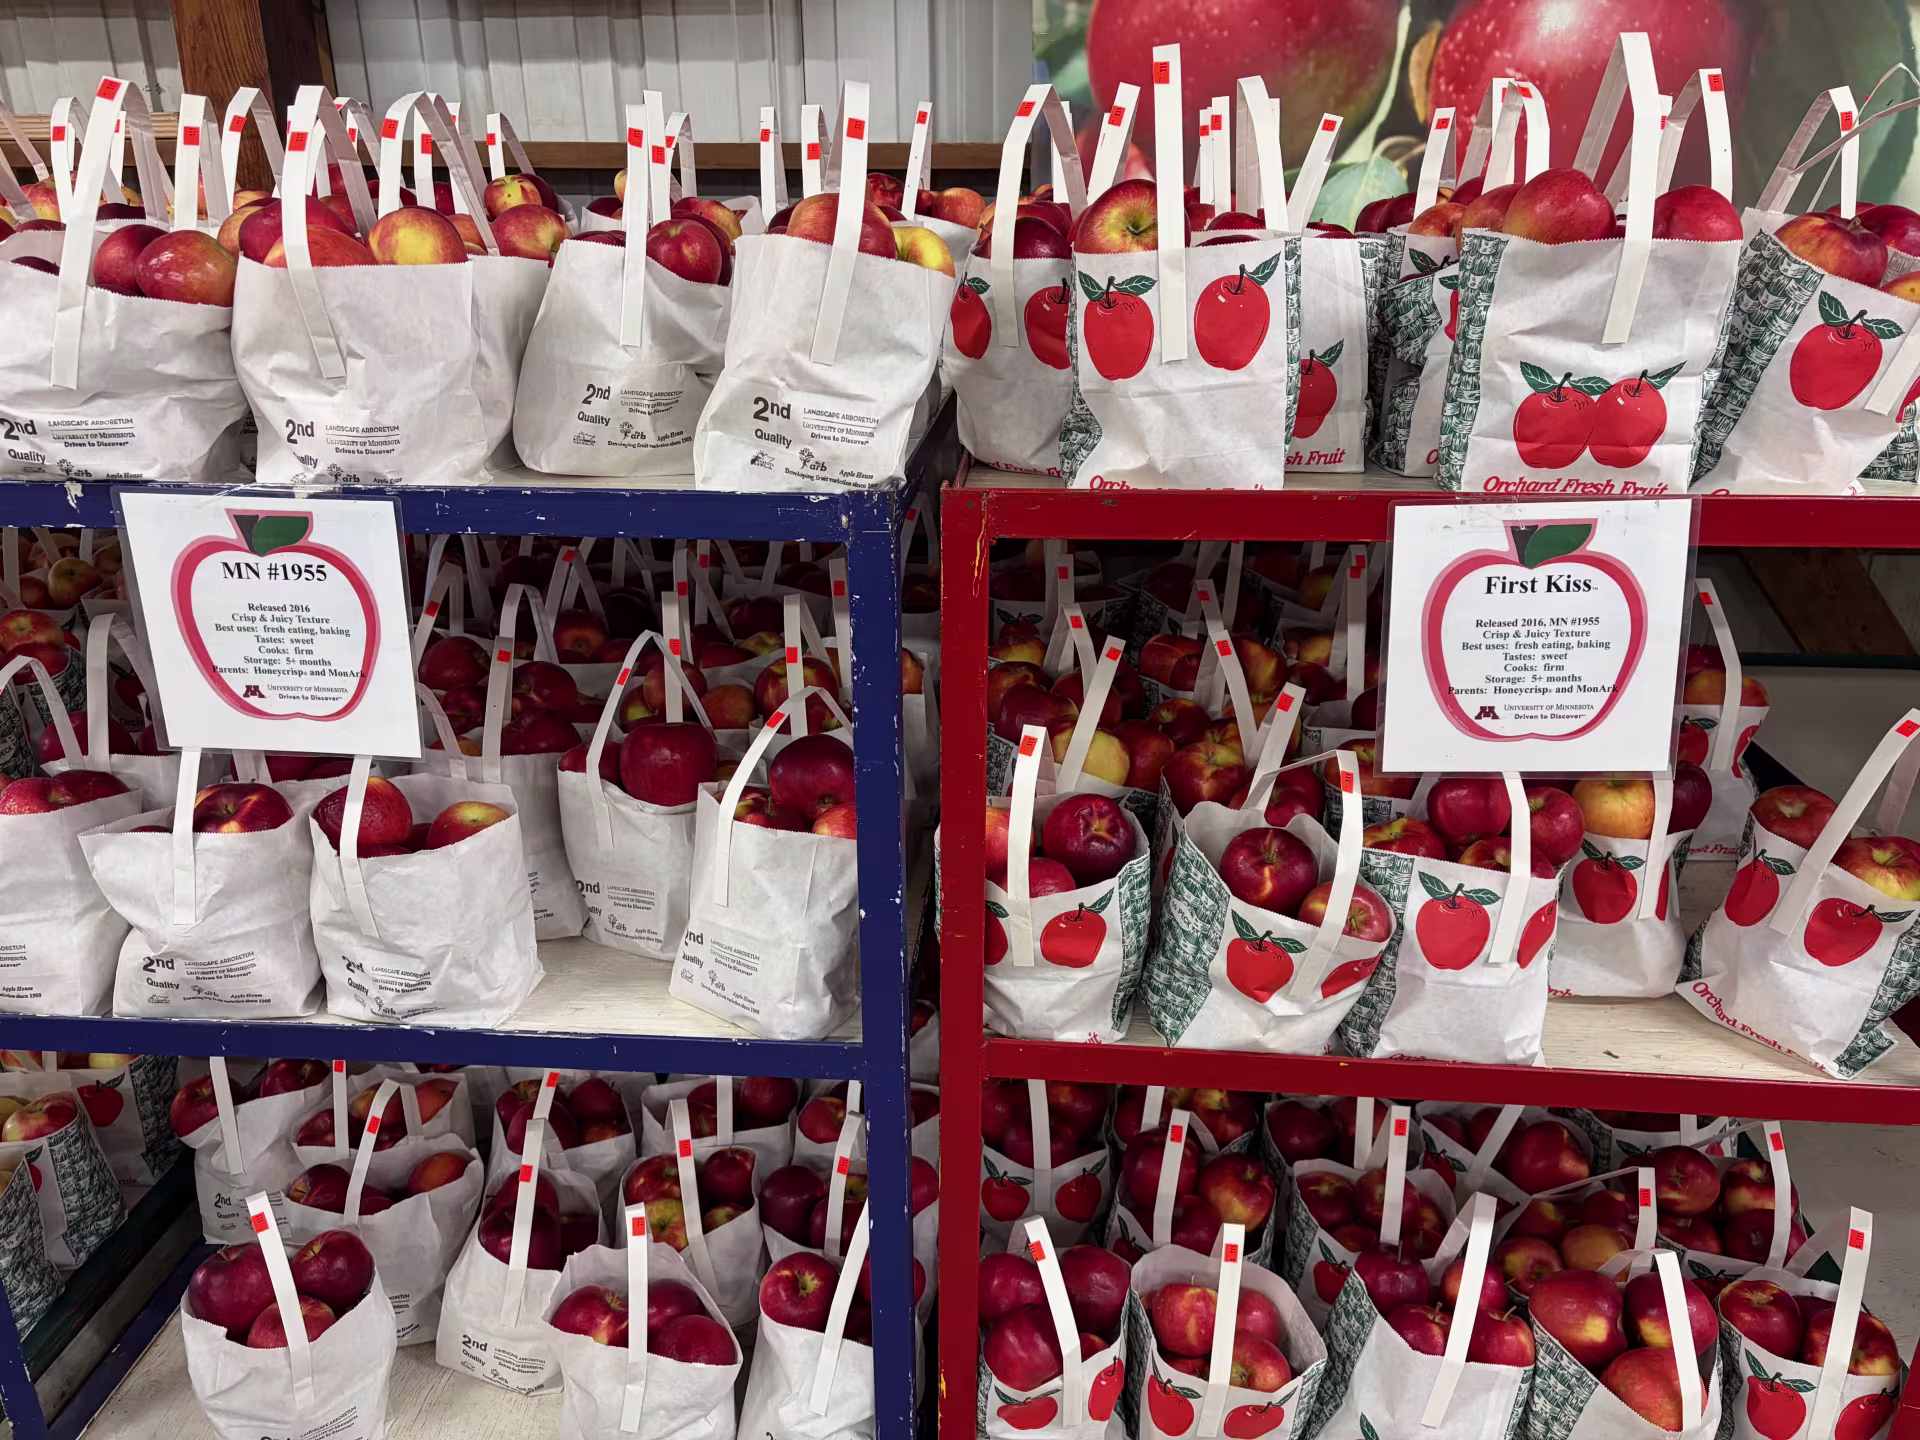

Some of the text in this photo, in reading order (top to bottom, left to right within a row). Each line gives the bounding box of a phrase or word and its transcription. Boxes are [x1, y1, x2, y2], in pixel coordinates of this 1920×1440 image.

[582, 384, 611, 405] 2nd
[620, 390, 653, 398] LANDSCAPE
[629, 407, 647, 416] Driven
[753, 396, 791, 423] 2nd
[578, 411, 611, 426] Quality
[803, 408, 880, 425] LANDSCAPE ARBORETUM
[0, 417, 38, 441] 2nd
[48, 418, 134, 428] LANDSCAPE ARBORETUM
[326, 424, 400, 434] LANDSCAPE ARBORETUM
[802, 422, 837, 433] UNIVERSITY
[98, 432, 136, 440] MINNESOTA
[286, 419, 315, 445] 2nd
[810, 432, 832, 441] Driven
[326, 438, 359, 447] UNIVERSITY
[754, 428, 793, 449] Quality
[64, 441, 87, 449] Driven
[335, 447, 356, 455] Driven
[8, 448, 46, 465] Quality
[1305, 447, 1346, 466] Fruit
[106, 472, 123, 480] Apple
[784, 467, 815, 481] Developing
[839, 469, 874, 480] Apple House
[1483, 476, 1669, 496] Orchard Fresh Fruit
[220, 561, 328, 582] MN #1955
[1484, 576, 1539, 595] First
[248, 602, 311, 613] Released 2016
[232, 613, 331, 625] Crisp & Juicy Texture
[1475, 616, 1600, 628] Released 2016, MN #1955
[214, 623, 351, 637] Best uses: fresh eating, baking
[1482, 628, 1591, 641] Crisp & Juicy Texture
[254, 634, 315, 645] Tastes: sweet
[1462, 640, 1611, 651] Best uses: fresh eating, baking
[258, 646, 314, 656] Cooks: firm
[1502, 652, 1569, 661] Tastes: sweet
[243, 656, 332, 667] Storage: 5+ months
[1504, 663, 1565, 672] Cooks: firm
[212, 665, 249, 675] Parents:
[309, 668, 327, 677] and
[328, 669, 367, 679] MonArk
[1484, 674, 1583, 685] Storage: 5+ months
[267, 684, 304, 692] UNIVERSITY
[313, 686, 349, 694] MINNESOTA
[1448, 686, 1488, 696] Parents:
[1555, 686, 1574, 694] and
[1576, 684, 1619, 694] MonArk
[278, 693, 301, 701] Driven
[220, 951, 255, 965] ARBORETUM
[142, 956, 175, 974] 2nd
[372, 966, 400, 976] LANDSCAPE
[146, 978, 180, 990] Quality
[347, 977, 369, 996] Quality
[1692, 982, 1783, 1051] Orchard Fresh
[214, 1192, 232, 1209] 2nd
[462, 1334, 488, 1352] 2nd
[462, 1348, 486, 1367] Quality
